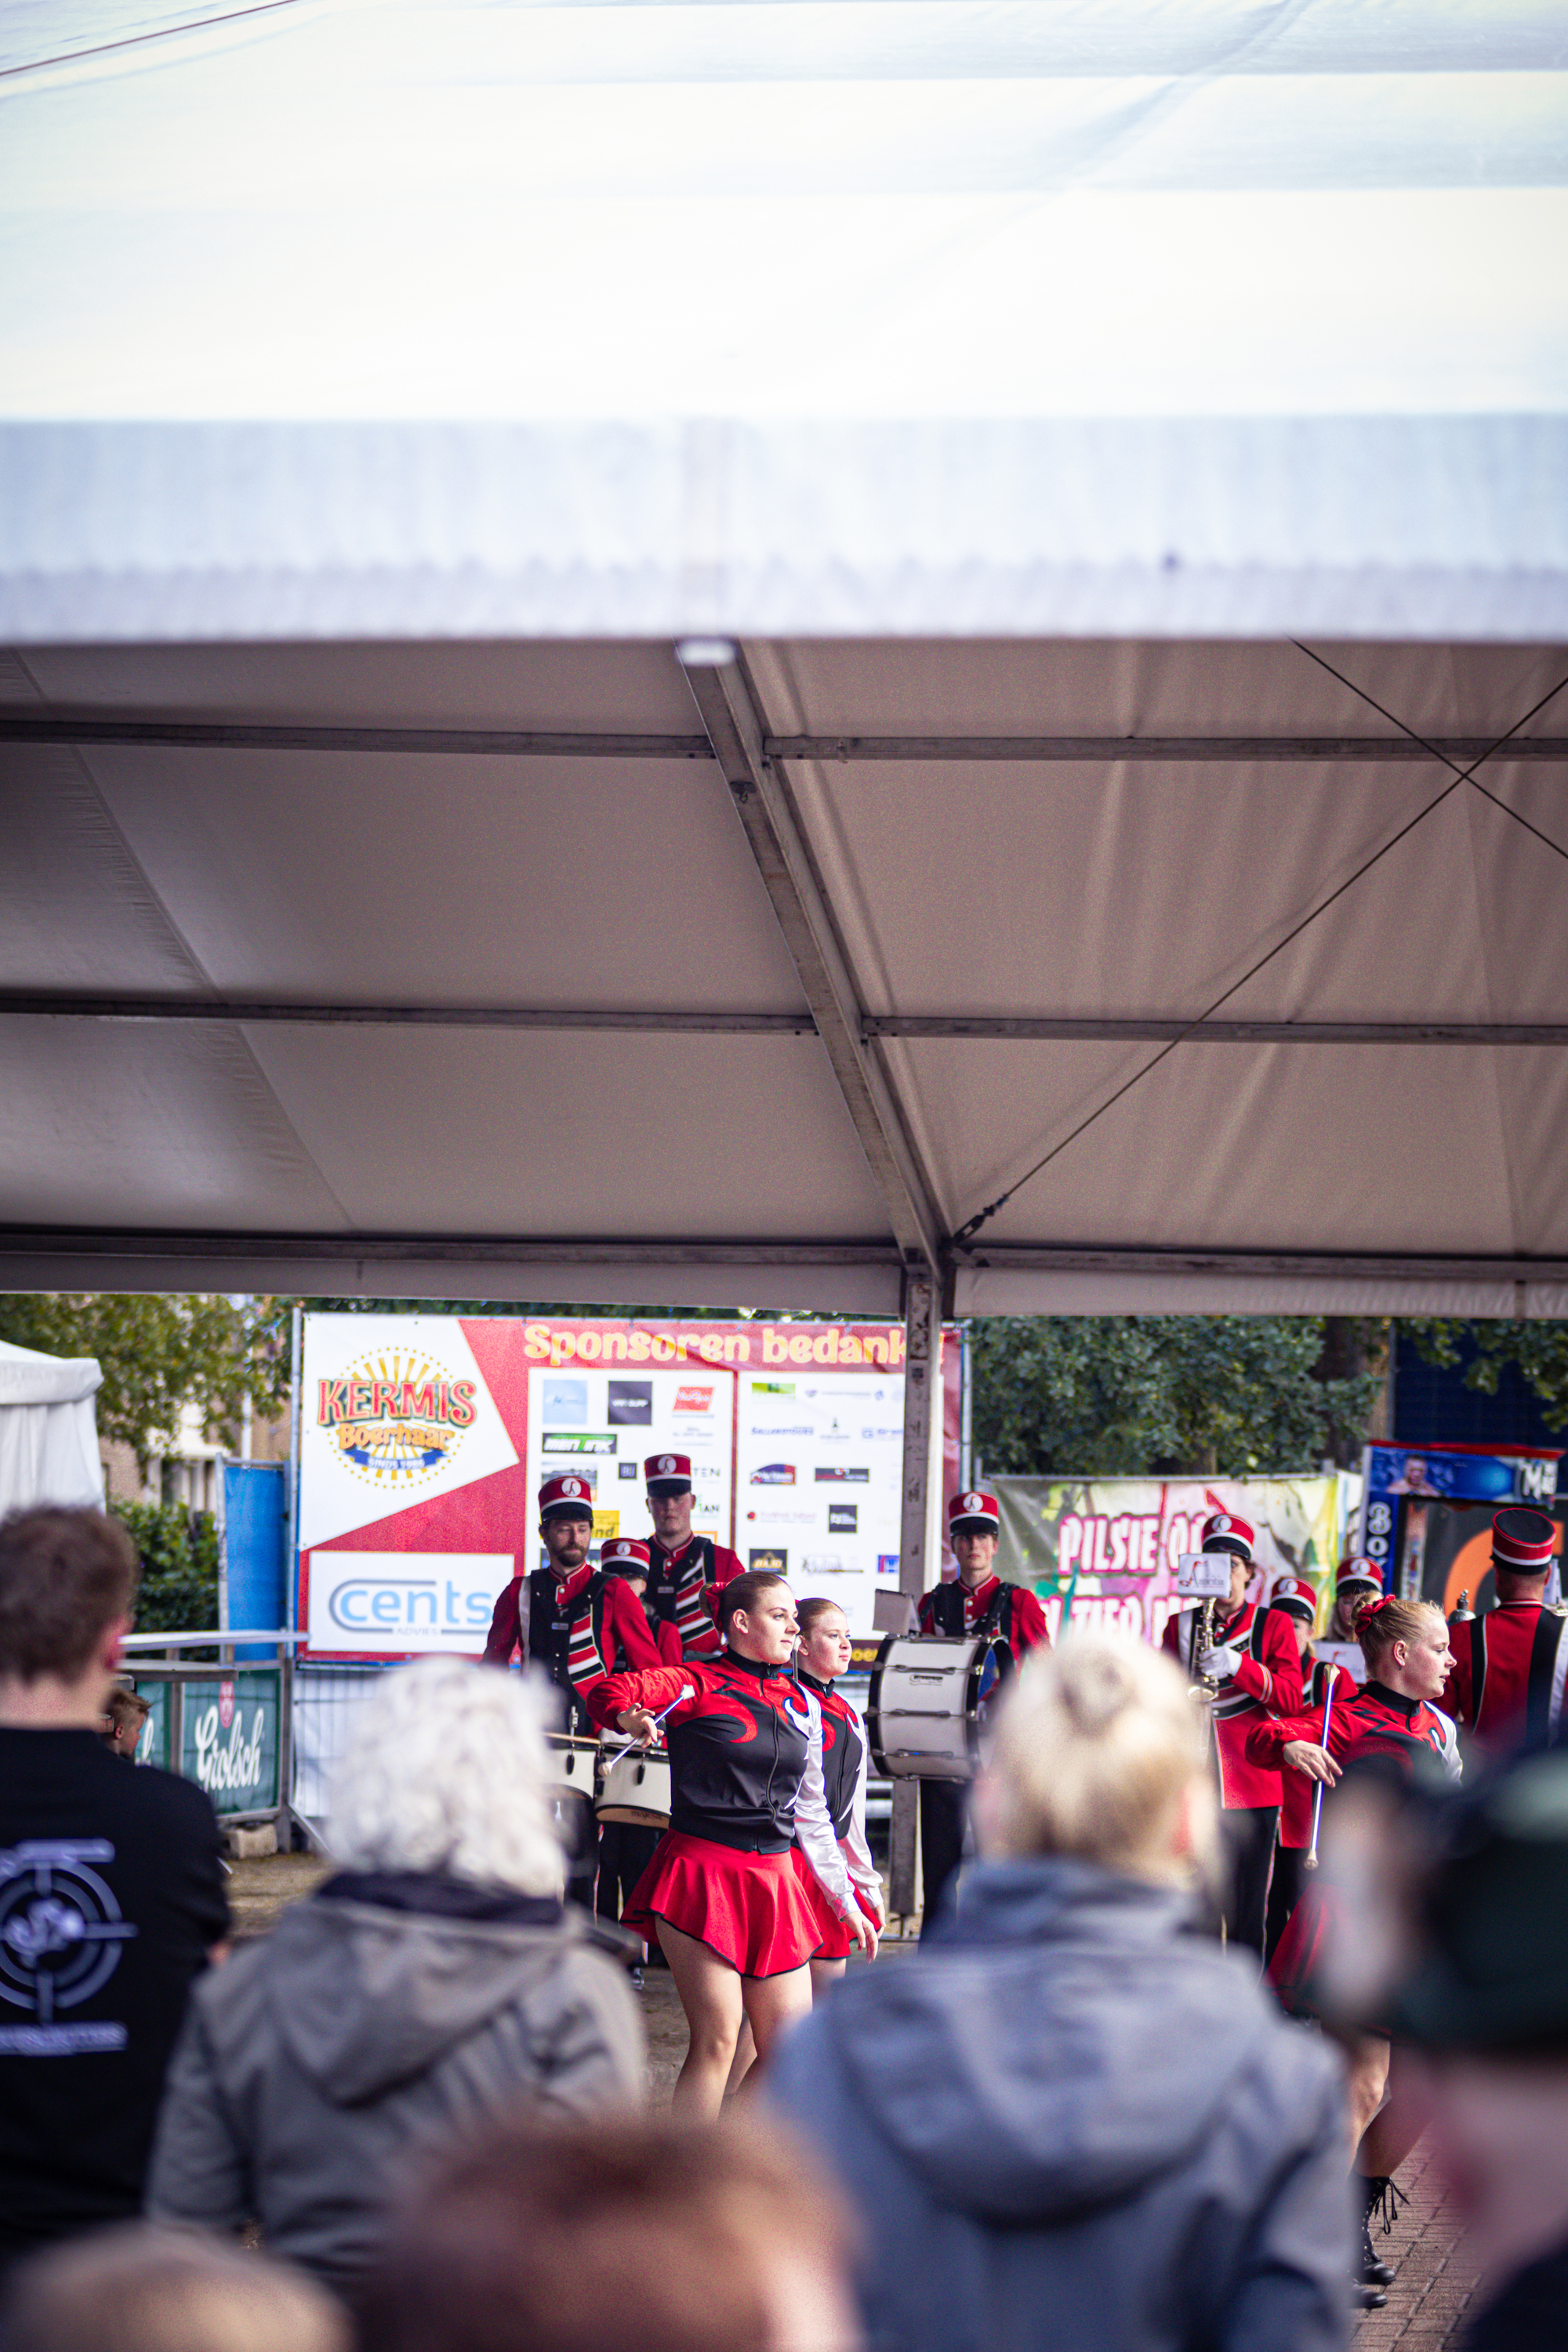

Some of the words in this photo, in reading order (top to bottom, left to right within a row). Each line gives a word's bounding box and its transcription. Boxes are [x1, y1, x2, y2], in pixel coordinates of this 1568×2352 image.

[524, 1324, 750, 1366] Sponsoren
[763, 1327, 944, 1364] bedank
[318, 1379, 477, 1427] KERMIS
[339, 1423, 456, 1450] Boerhaar
[368, 1457, 399, 1469] SINDS
[1058, 1513, 1160, 1574] PILSIE
[340, 1581, 493, 1624] cents
[195, 1705, 263, 1792] Grolsch
